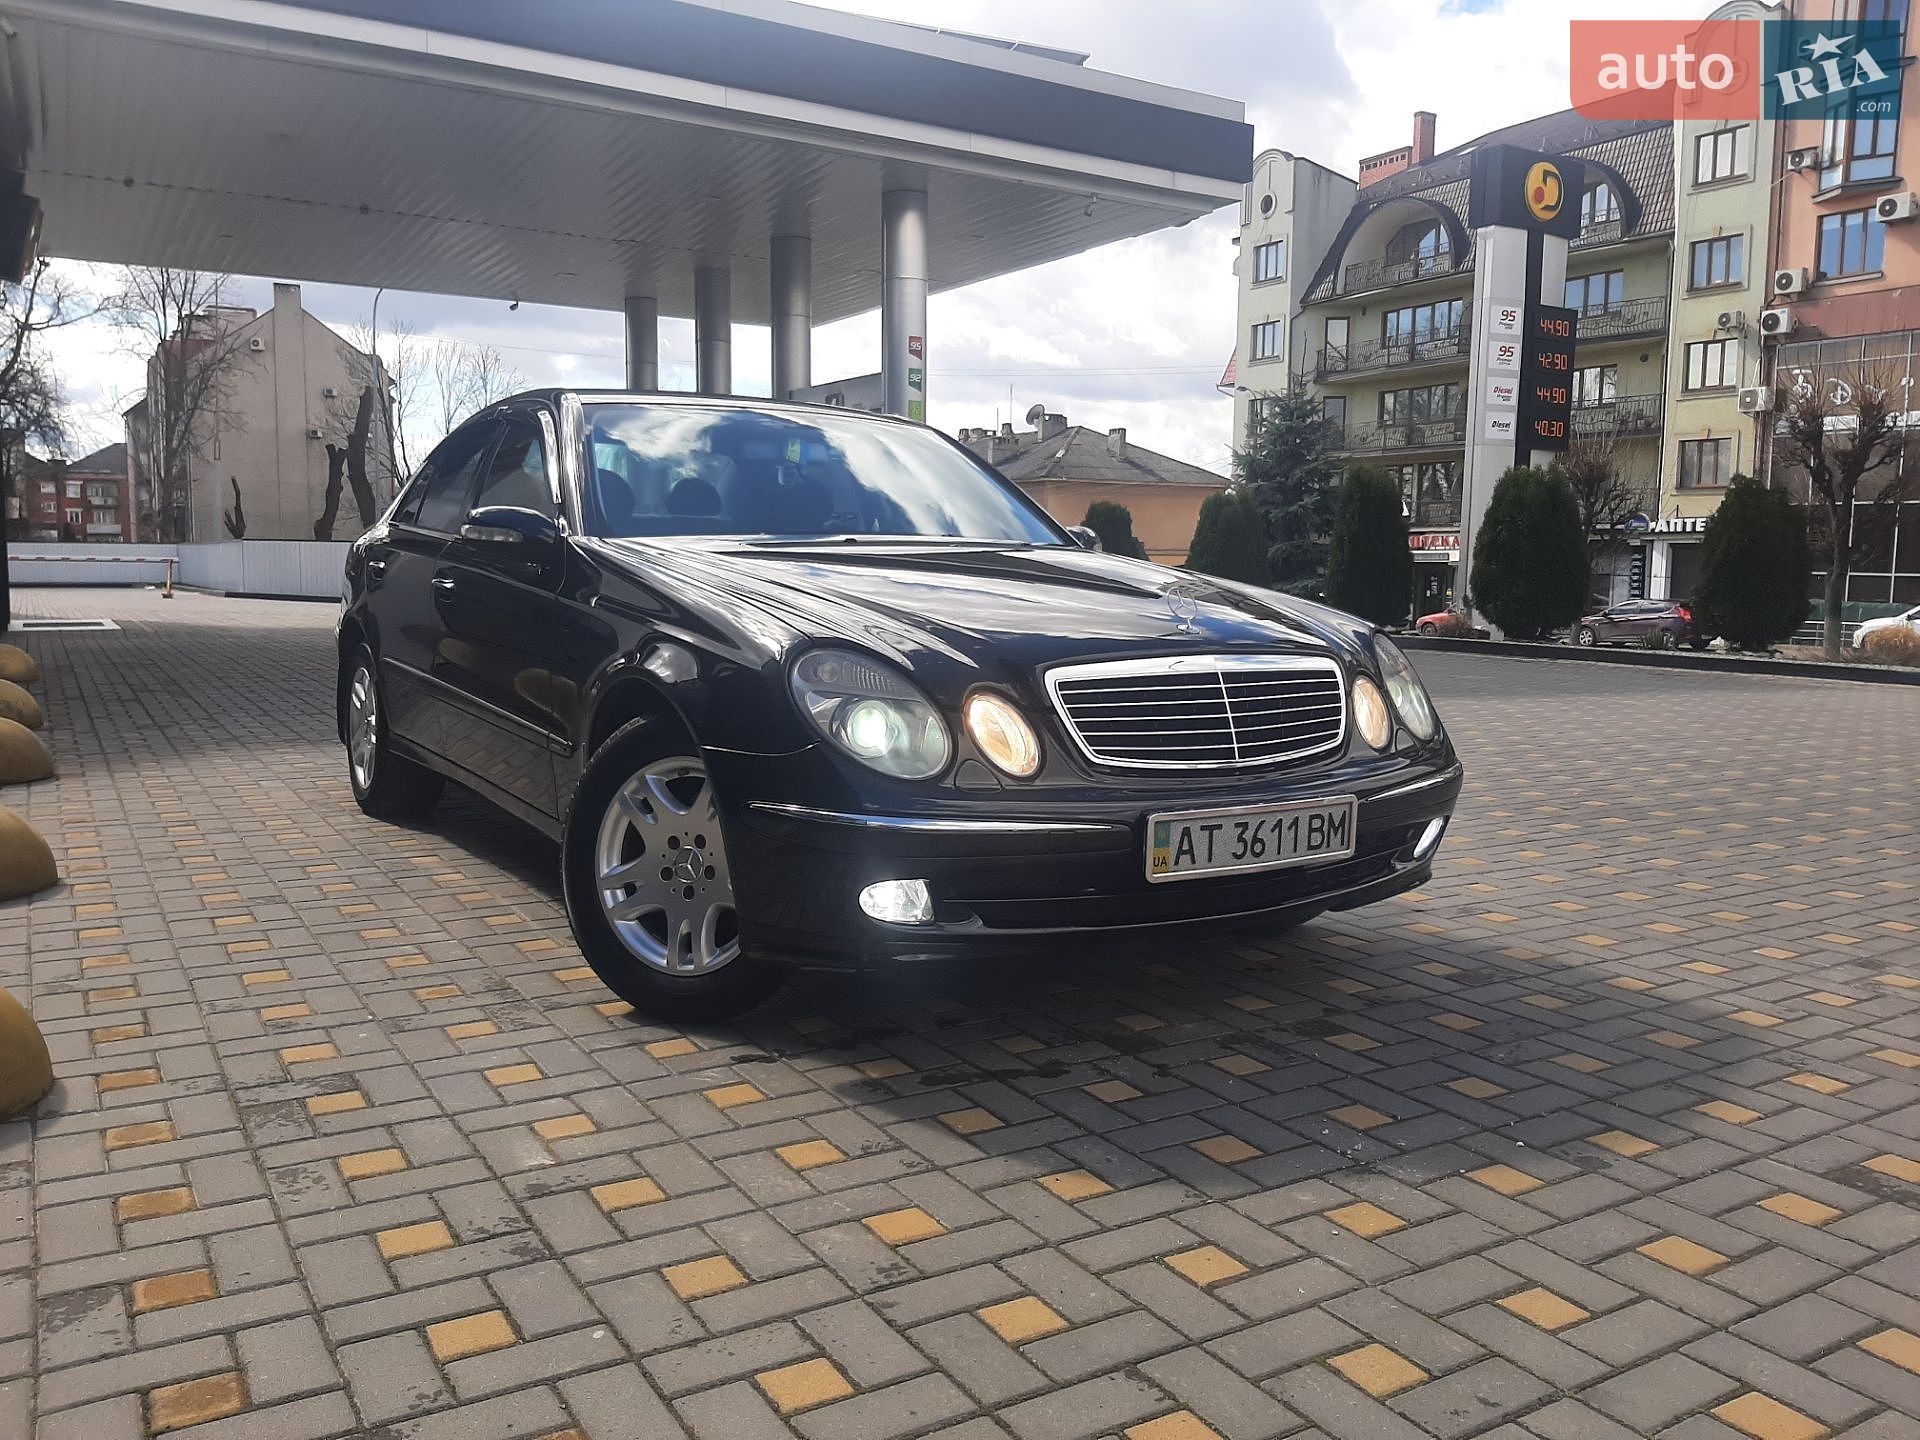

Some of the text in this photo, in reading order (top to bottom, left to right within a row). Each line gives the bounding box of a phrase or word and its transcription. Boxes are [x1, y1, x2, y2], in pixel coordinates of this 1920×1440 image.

[1500, 309, 1516, 322] 95
[910, 341, 922, 351] 95
[1498, 345, 1515, 358] 95
[1493, 386, 1513, 395] Diesel
[1491, 420, 1511, 429] Diesel
[1655, 517, 1707, 533] АПТЕ
[1409, 534, 1460, 549] ПТЕКА
[1173, 810, 1347, 866] AT 3611 BM
[1153, 856, 1168, 868] UA
